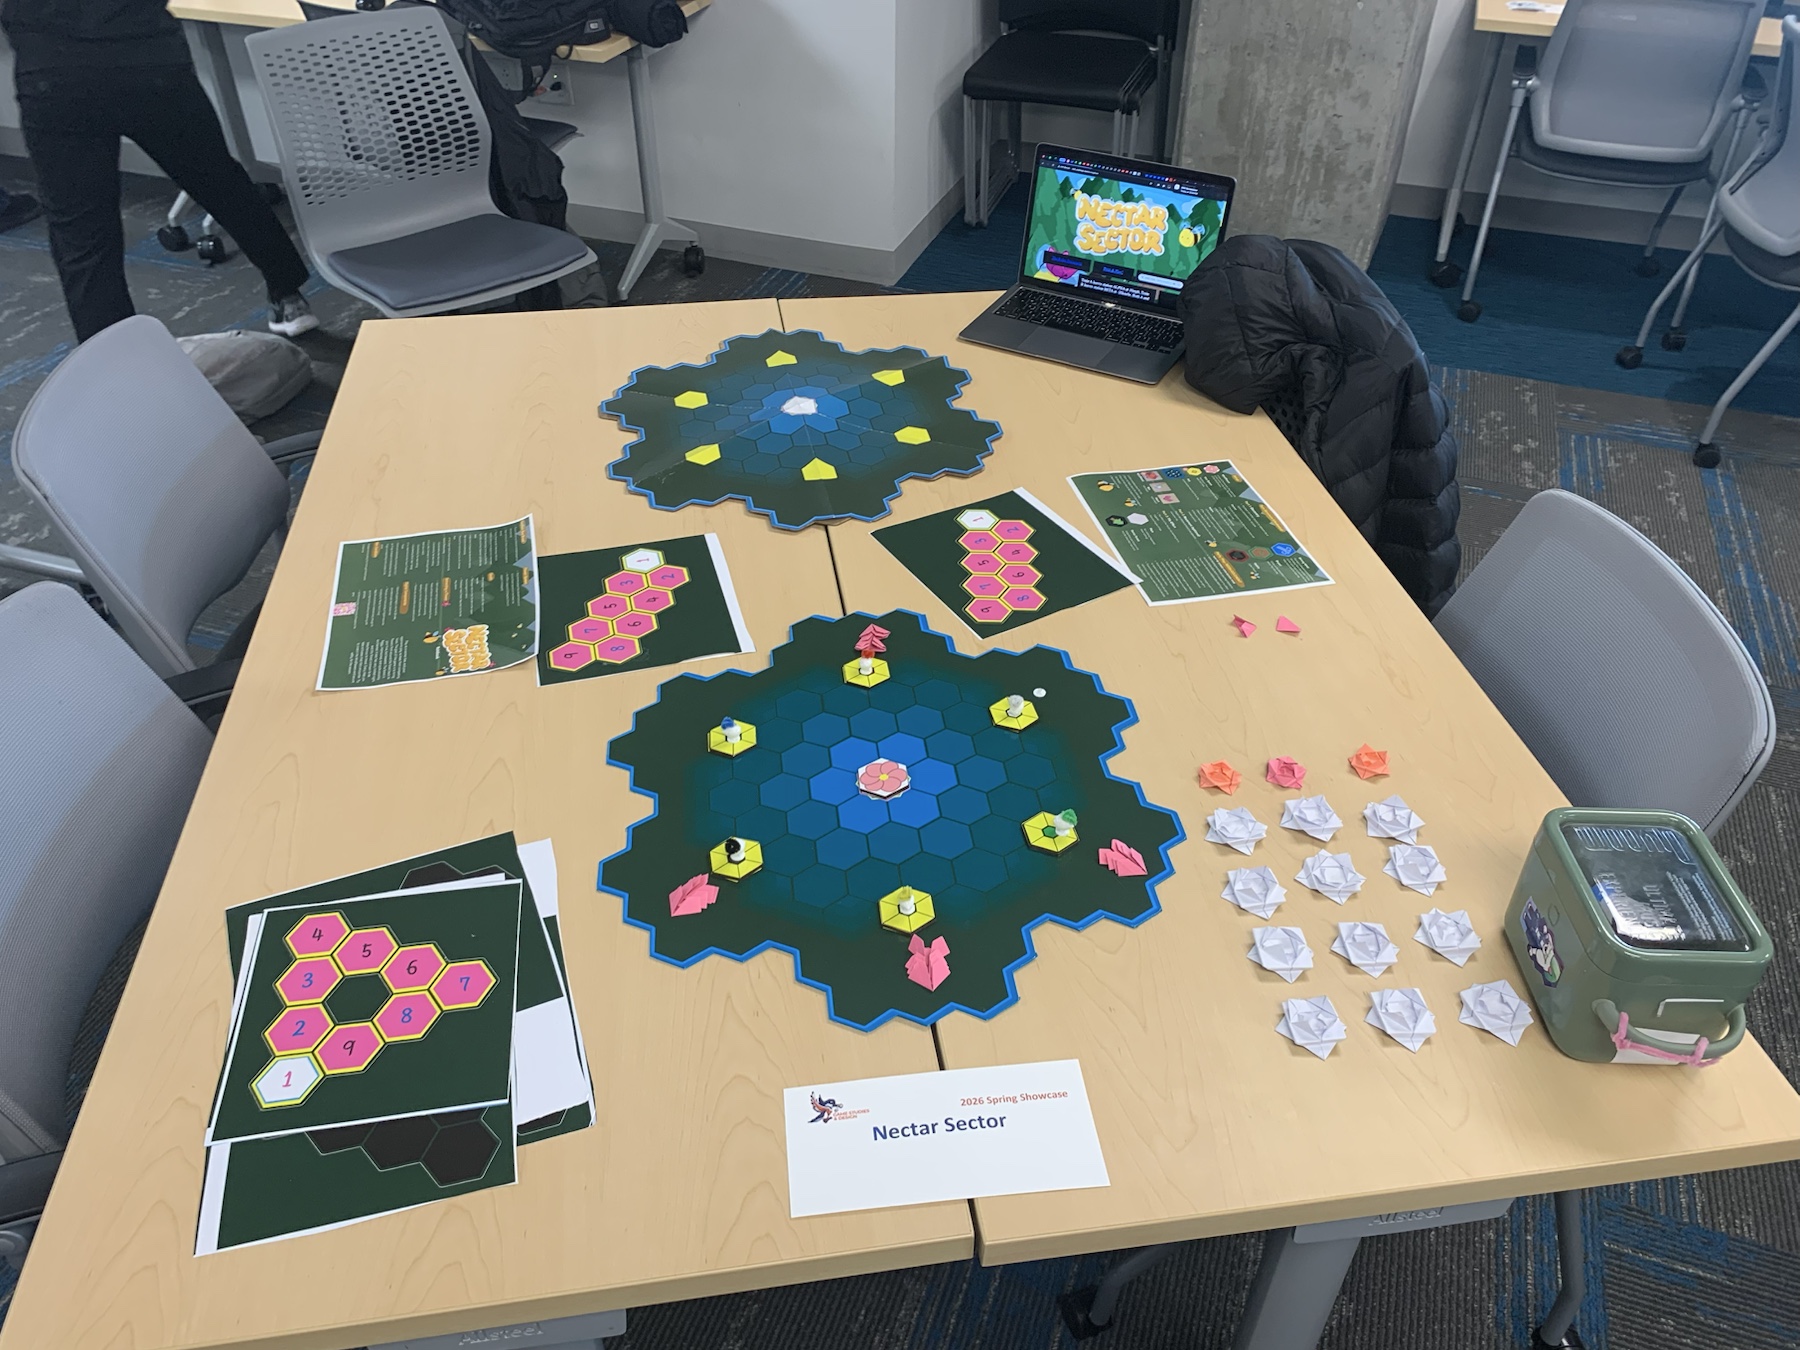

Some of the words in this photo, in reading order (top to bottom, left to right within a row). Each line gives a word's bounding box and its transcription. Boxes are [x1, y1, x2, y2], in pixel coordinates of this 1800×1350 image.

[1077, 194, 1167, 232] NECTAR
[1076, 223, 1164, 254] SECTOR
[619, 579, 634, 587] 3
[603, 602, 617, 610] 5
[311, 927, 324, 942] 4
[361, 943, 373, 958] 5
[406, 959, 418, 976] 6
[301, 972, 314, 988] 3
[459, 976, 471, 992] 7
[400, 1007, 413, 1023] 8
[292, 1020, 306, 1037] 2
[342, 1040, 356, 1057] 9
[281, 1071, 294, 1089] 1
[960, 1095, 984, 1107] 2026
[986, 1092, 1018, 1106] Spring
[1019, 1089, 1069, 1102] Showcase
[872, 1118, 939, 1141] Nectar
[944, 1112, 1007, 1133] Sector
[1368, 1206, 1444, 1227] Allsteel
[458, 1322, 544, 1346] Allsteel
